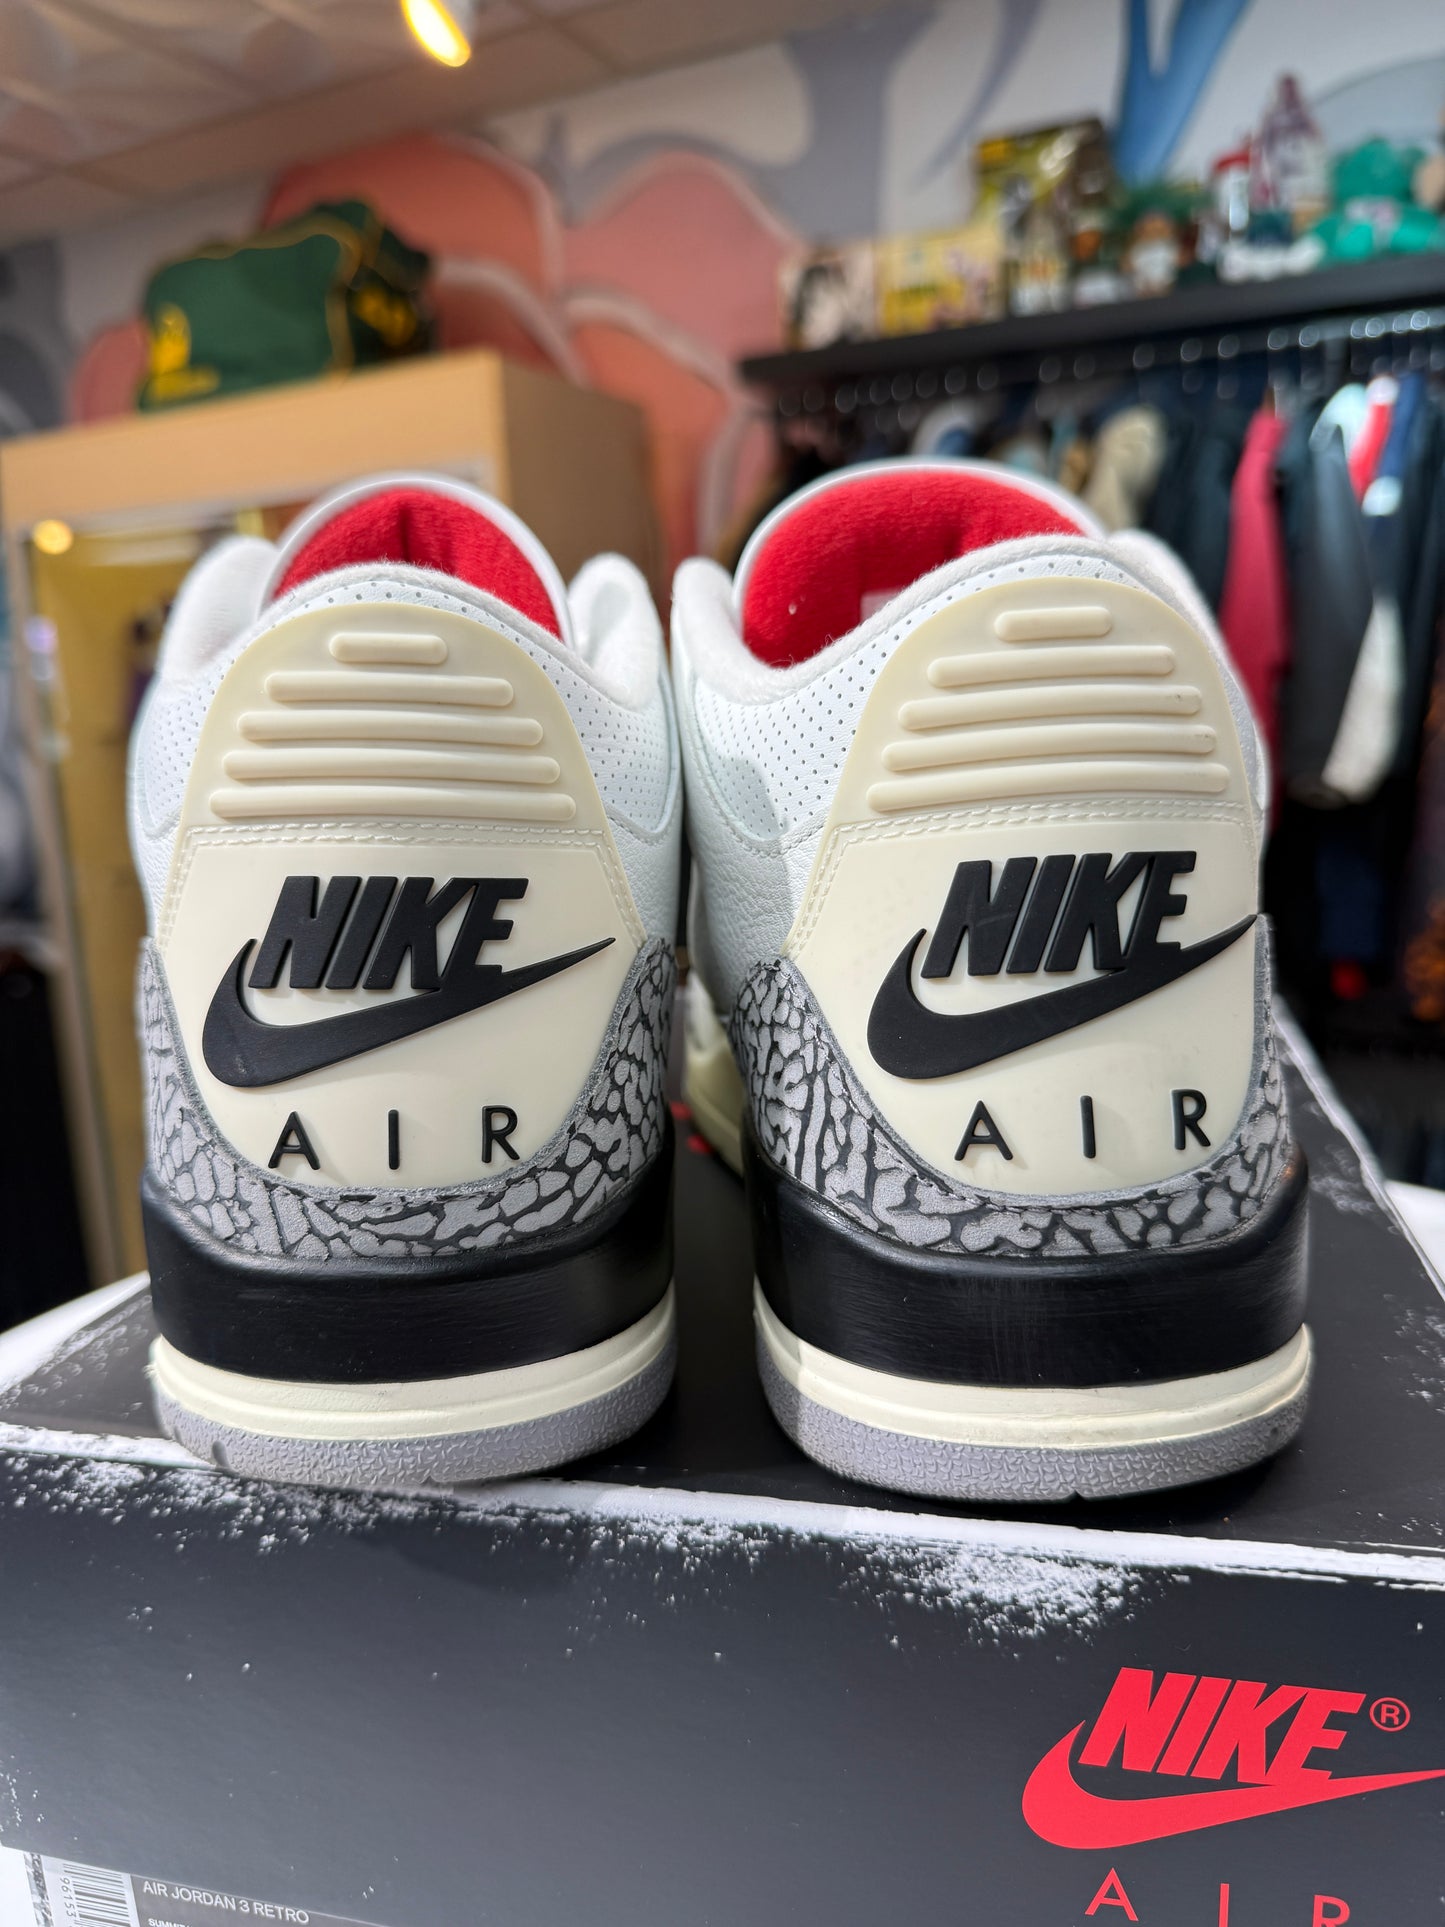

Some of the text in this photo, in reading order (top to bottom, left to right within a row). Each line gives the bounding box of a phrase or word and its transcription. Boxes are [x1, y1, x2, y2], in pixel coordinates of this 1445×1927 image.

[248, 876, 530, 990] NIKE
[920, 850, 1197, 979] NIKE
[268, 1106, 520, 1170] AIR
[954, 1089, 1208, 1161] AIR
[1078, 1667, 1367, 1786] NIKE
[143, 1880, 309, 1923] AIR JORDAN 3 RETRO
[1084, 1868, 1351, 1927] AIR
